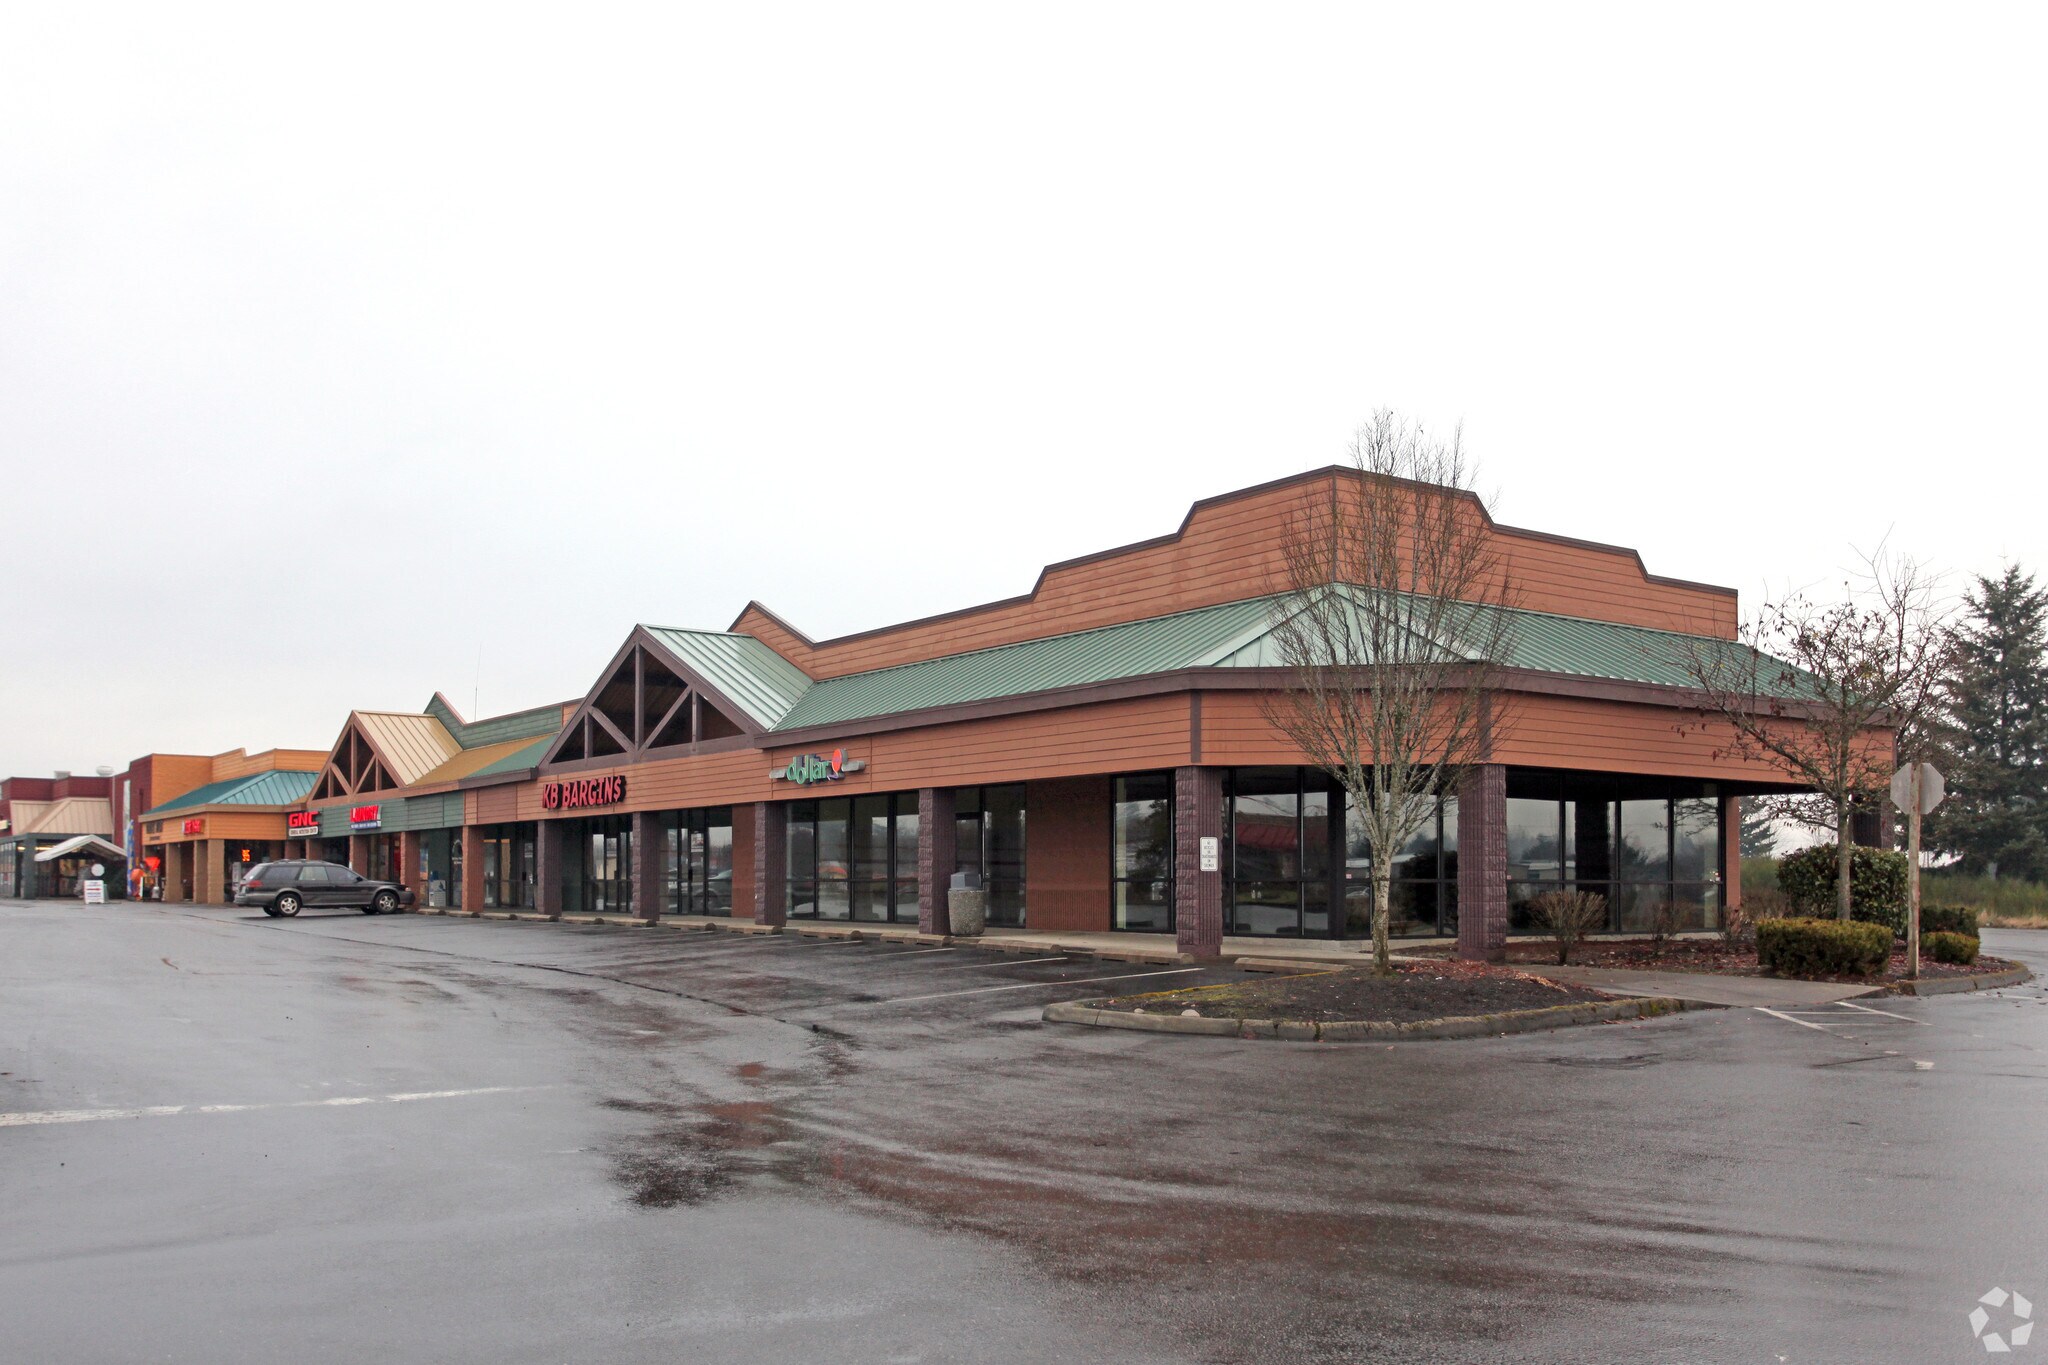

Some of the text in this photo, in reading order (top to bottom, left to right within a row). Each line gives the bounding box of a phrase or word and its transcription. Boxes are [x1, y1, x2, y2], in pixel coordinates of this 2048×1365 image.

[787, 754, 829, 785] dollar
[543, 775, 624, 809] KB BARGIN$
[288, 811, 320, 827] GNC
